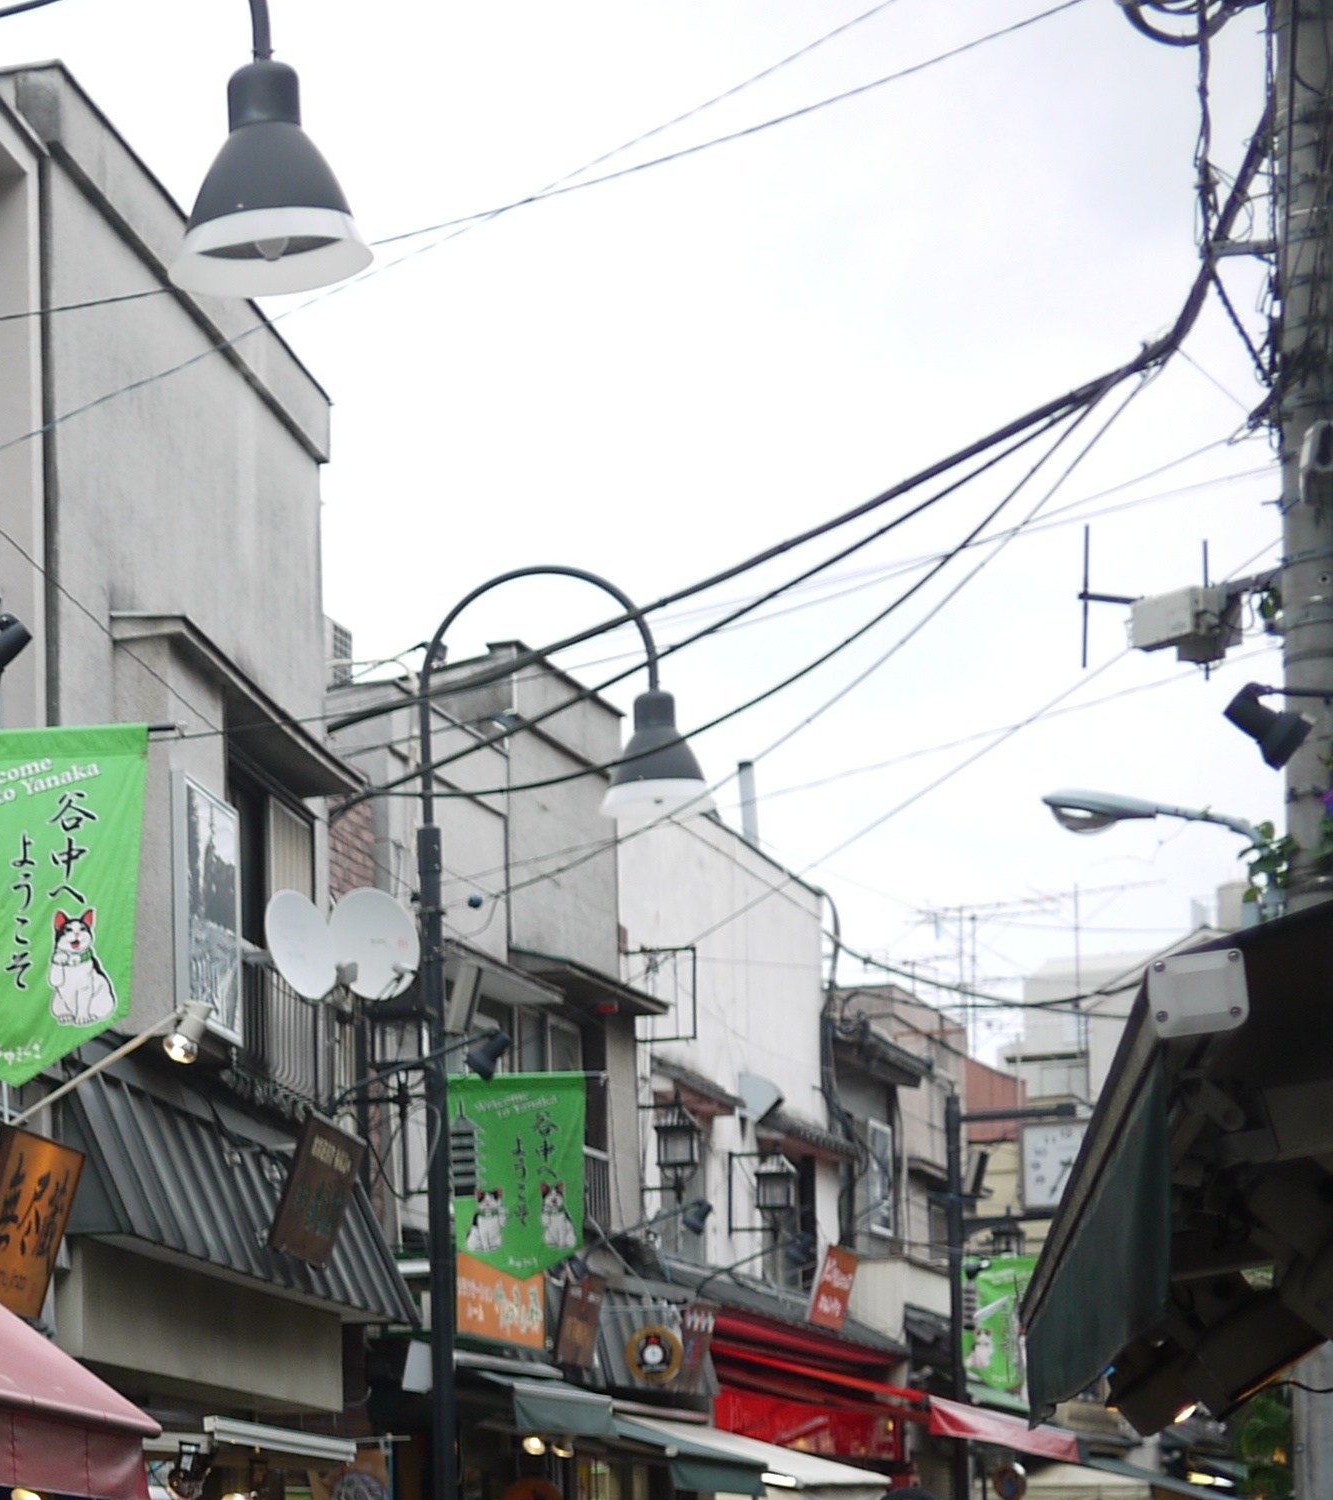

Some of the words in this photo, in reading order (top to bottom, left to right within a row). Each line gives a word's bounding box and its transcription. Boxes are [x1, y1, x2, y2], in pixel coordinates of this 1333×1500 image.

[20, 762, 101, 797] Yanaka
[48, 791, 97, 904] 谷中へ
[5, 831, 36, 989] ようこそ
